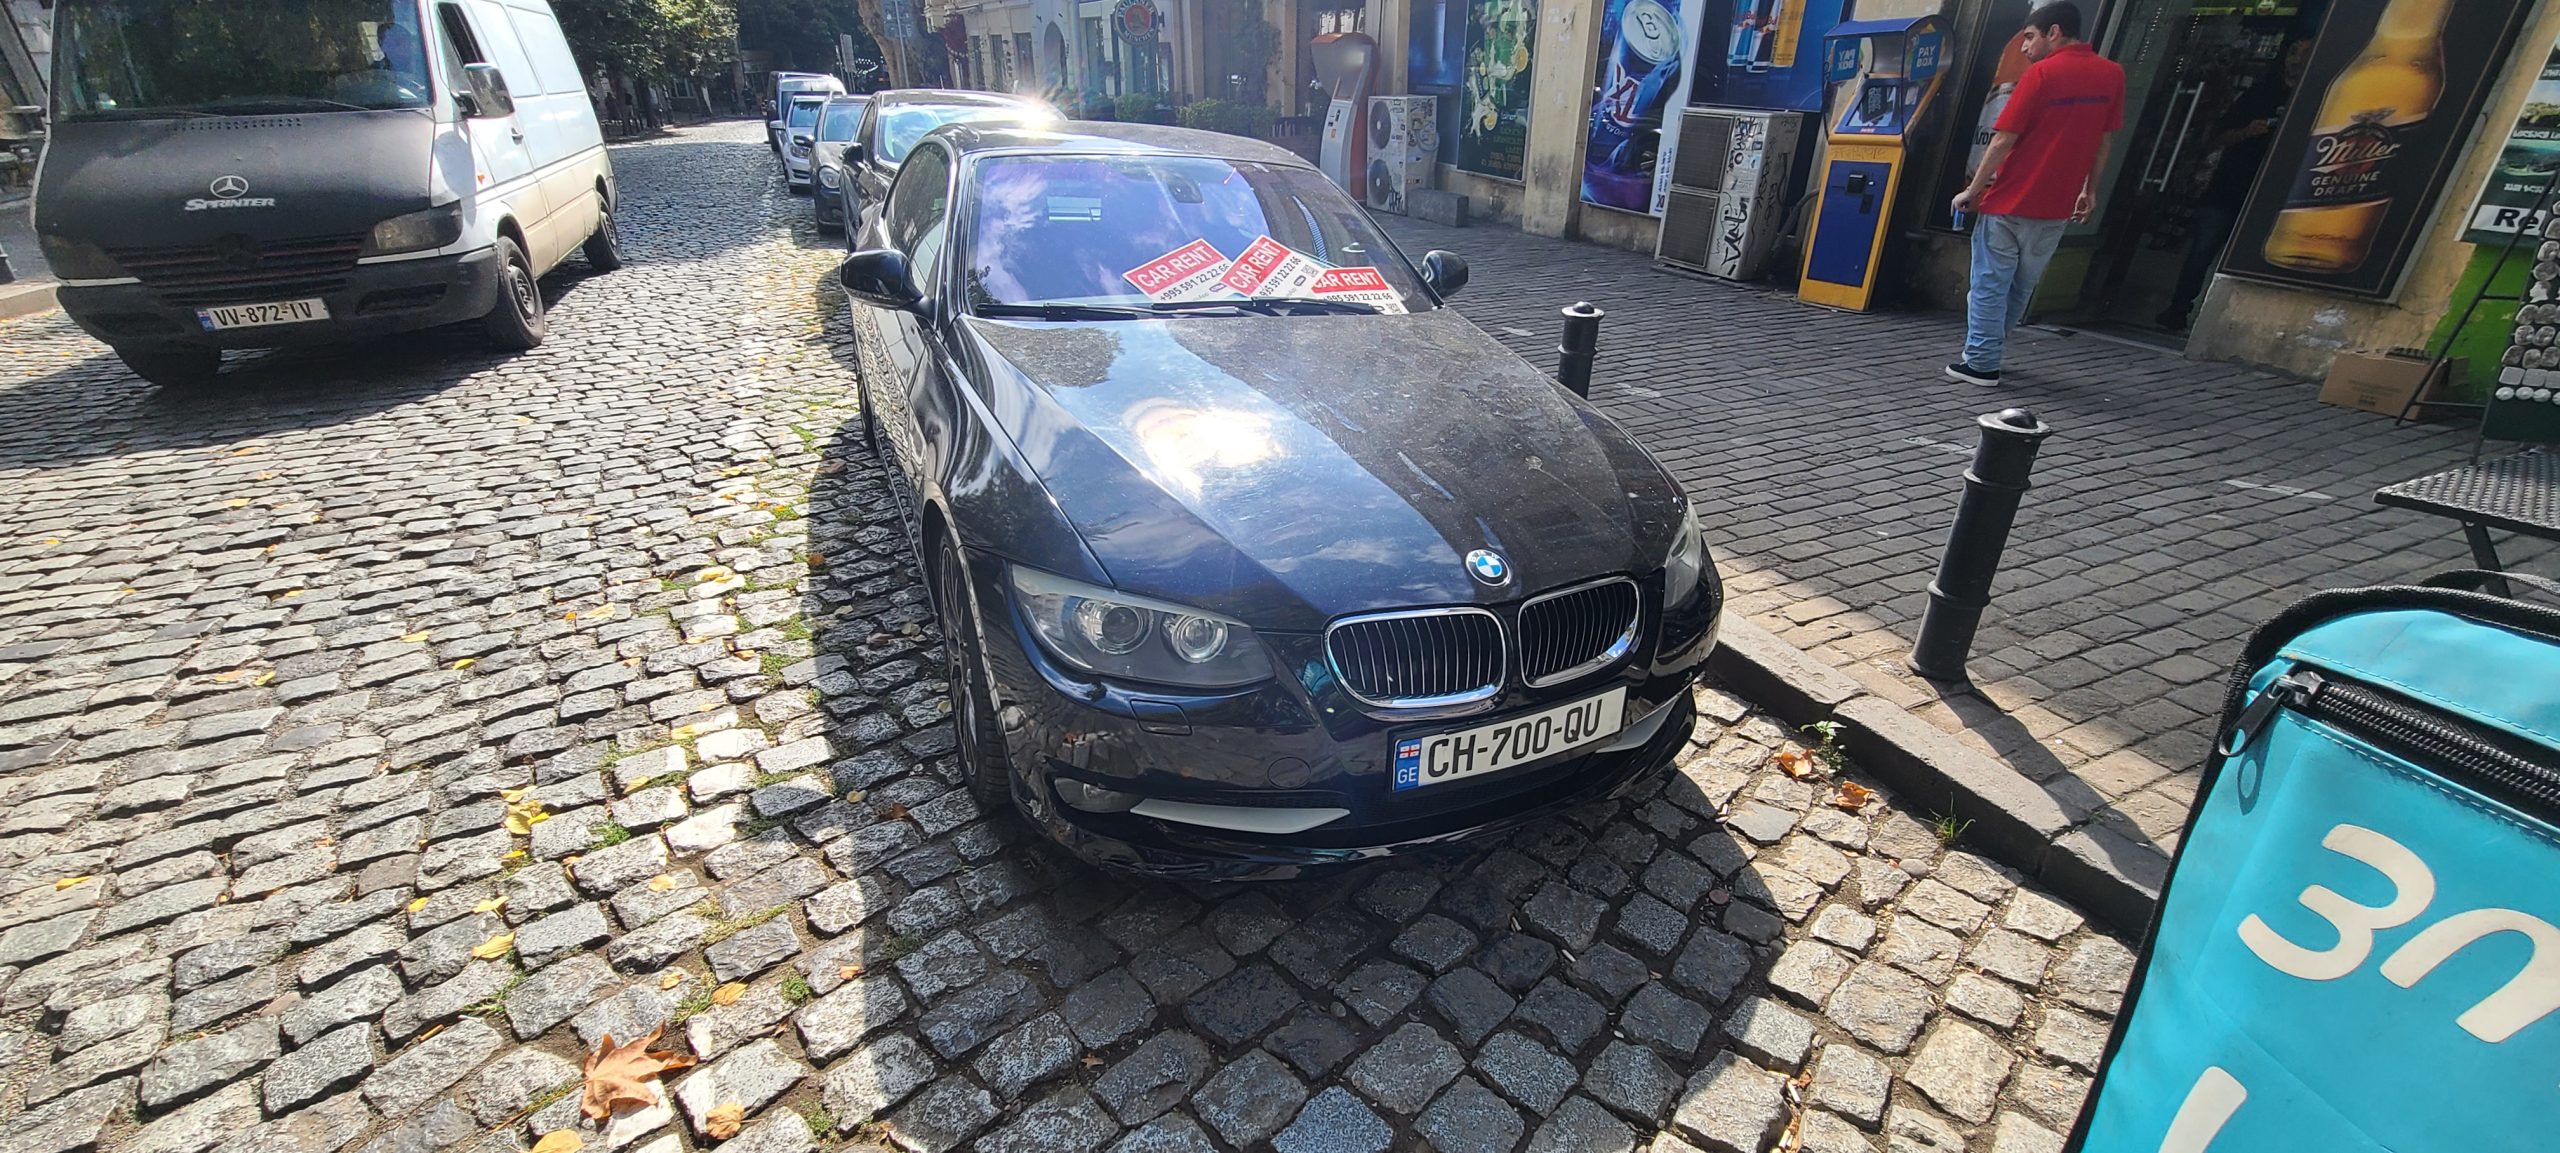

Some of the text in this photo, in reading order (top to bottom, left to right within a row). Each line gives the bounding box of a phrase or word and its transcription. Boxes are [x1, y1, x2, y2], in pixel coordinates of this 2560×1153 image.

[1918, 45, 1936, 57] PAY
[1916, 57, 1934, 68] BOX
[2316, 136, 2401, 166] Miller
[2311, 170, 2381, 186] GENUINE
[2313, 183, 2368, 197] DRAFT
[184, 197, 276, 212] SPRINTER
[1136, 245, 1214, 288] CAR RENT
[1229, 241, 1281, 290] CAR RENT
[1283, 262, 1296, 272] 22
[1268, 275, 1284, 288] 591
[1277, 269, 1290, 279] 22
[1340, 271, 1380, 287] RENT
[1160, 286, 1182, 301] +995
[1180, 279, 1198, 292] 591
[1344, 293, 1360, 301] 591
[1360, 293, 1372, 301] 22
[1382, 292, 1393, 300] 66
[213, 301, 312, 326] VV-872-IV
[1427, 699, 1603, 778] CH-700-QU
[1397, 767, 1417, 784] GE
